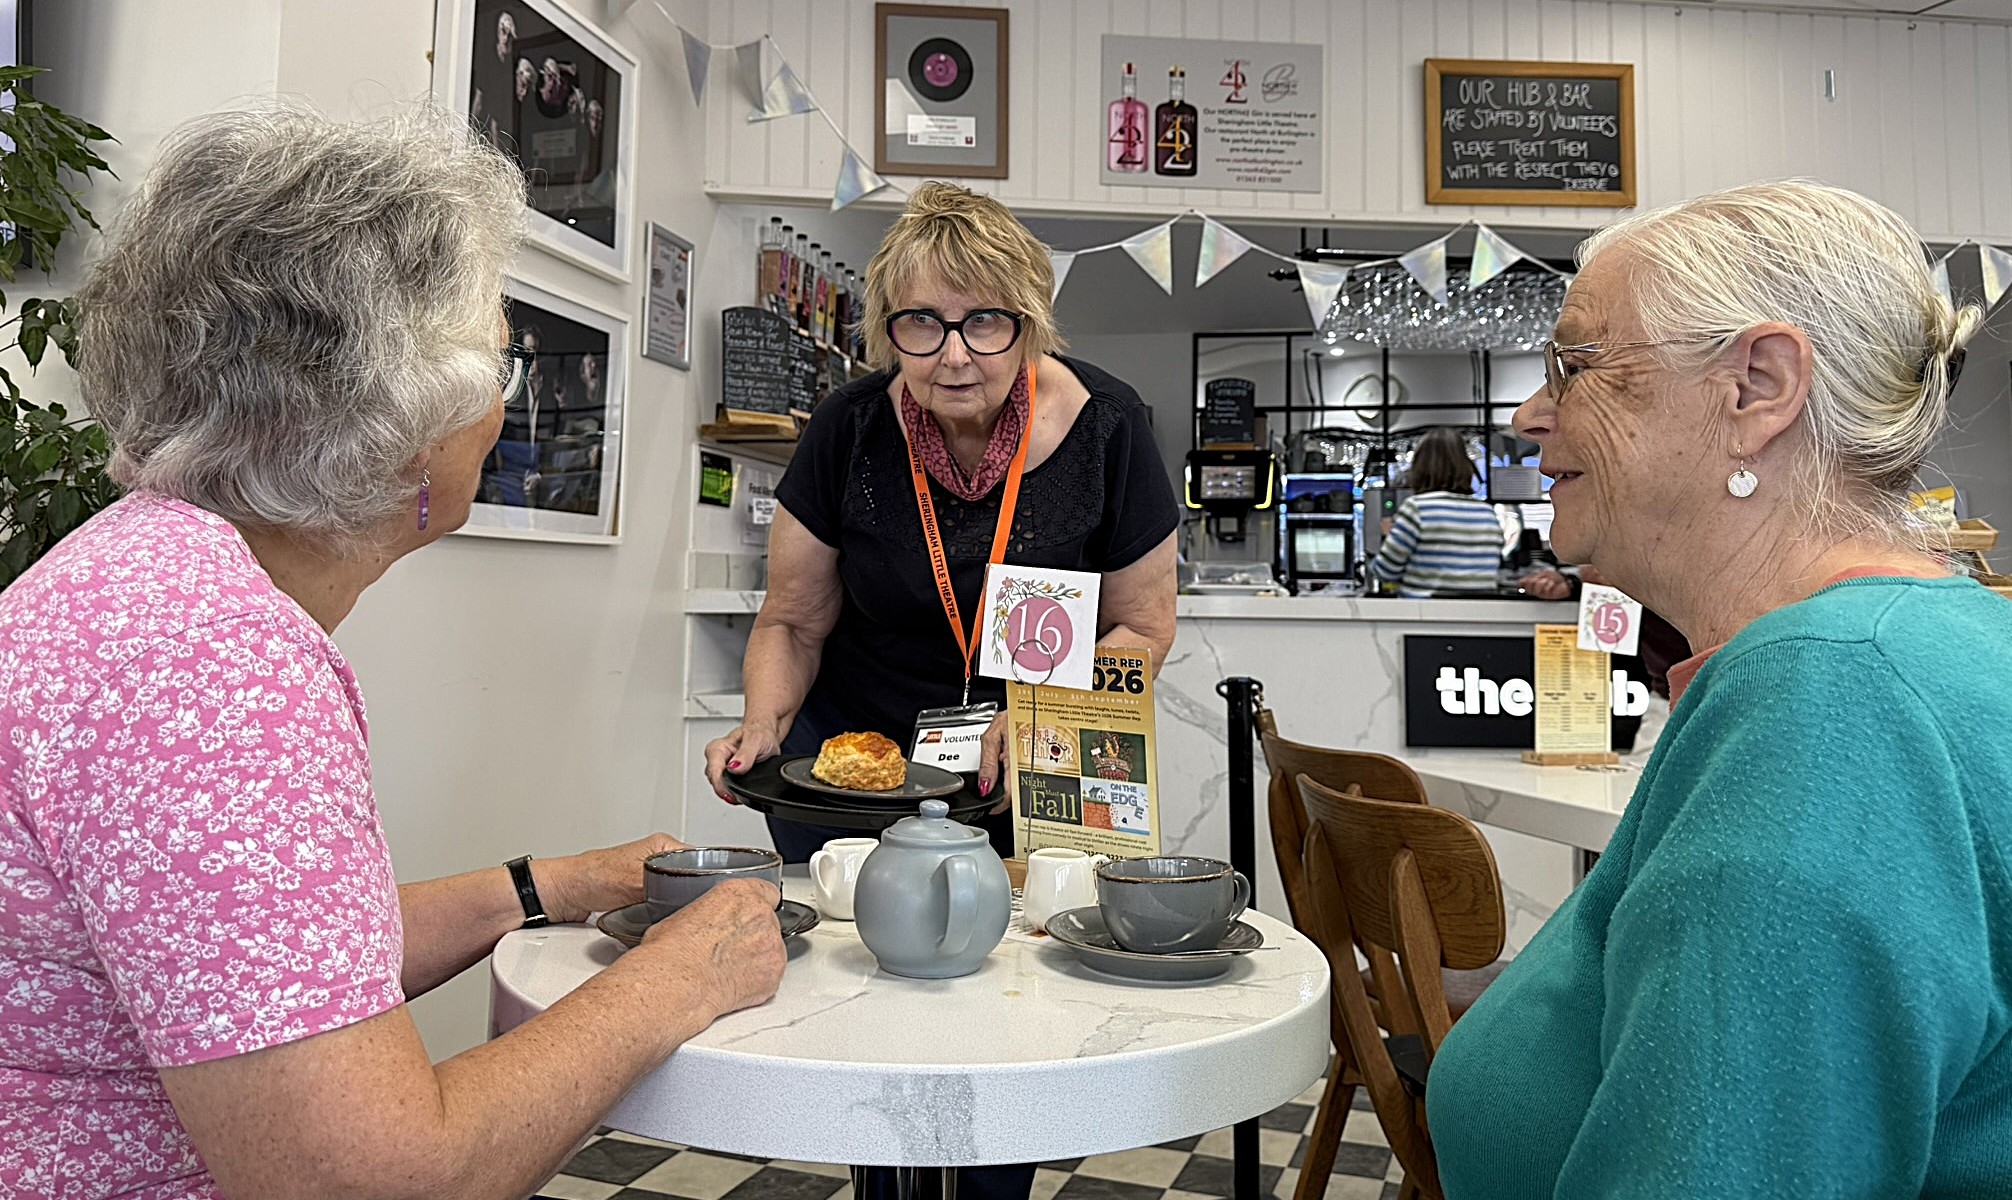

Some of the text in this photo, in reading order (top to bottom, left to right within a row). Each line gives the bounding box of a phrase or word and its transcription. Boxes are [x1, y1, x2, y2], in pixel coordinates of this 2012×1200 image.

[1459, 79, 1593, 110] OUR HUB & BAR
[1443, 108, 1467, 132] ARE
[1471, 108, 1524, 129] STAFFED
[1526, 110, 1546, 137] BY
[1452, 138, 1588, 162] PLEASE TREAT THEM
[1446, 160, 1609, 181] WITH THE RESPECT THEY
[919, 492, 957, 619] SHERINGHAM LITTLE THEATRE
[1017, 603, 1062, 655] 16
[1597, 607, 1623, 636] 15
[1120, 658, 1143, 669] REP
[1092, 666, 1145, 695] 026
[1435, 667, 1534, 717] the
[1089, 694, 1139, 705] September
[944, 734, 981, 743] VOLUNTE
[938, 753, 960, 762] Dee
[1021, 776, 1047, 790] Night
[1110, 782, 1138, 793] ON THE
[1031, 790, 1078, 821] Fall
